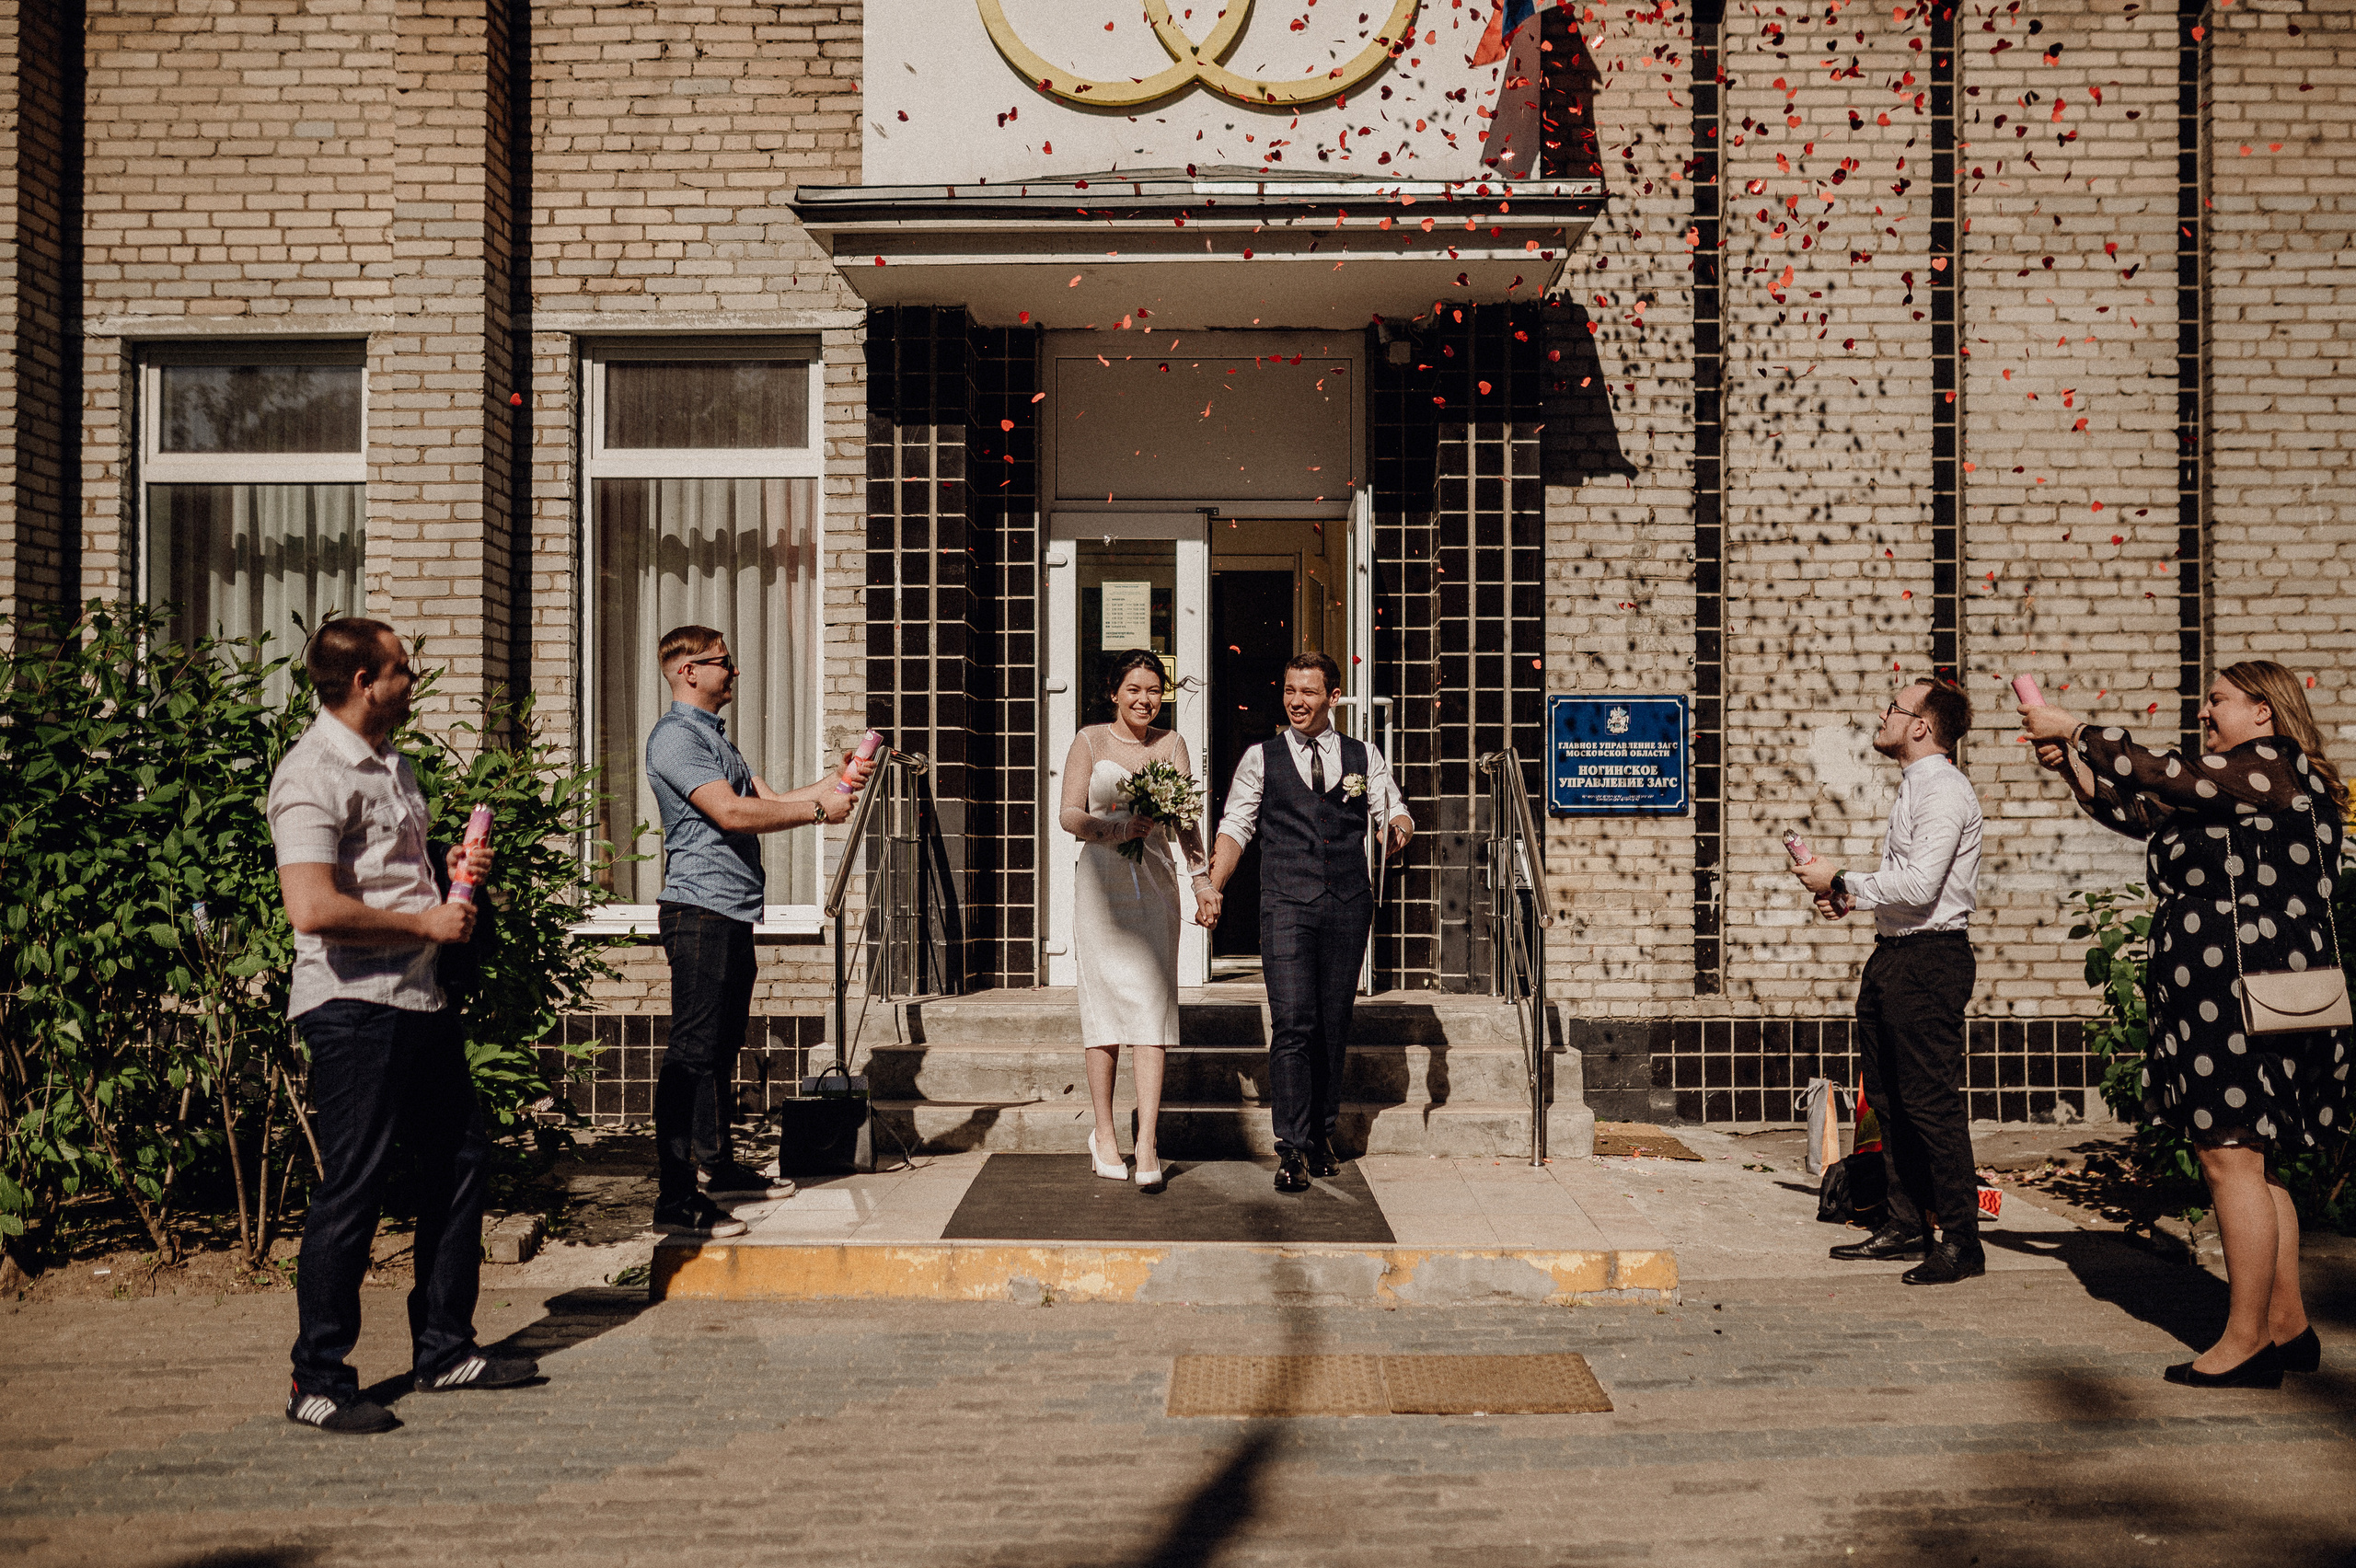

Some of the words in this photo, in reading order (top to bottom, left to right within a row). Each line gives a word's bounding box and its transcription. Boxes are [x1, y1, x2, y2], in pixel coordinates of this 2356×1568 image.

[1565, 749, 1627, 757] МОСКОВСКОЙ
[1578, 765, 1658, 776] НОГИНСКОЕ
[1558, 778, 1645, 788] УПРАВЛЕНИЕ
[1646, 778, 1678, 788] ЗАГС
